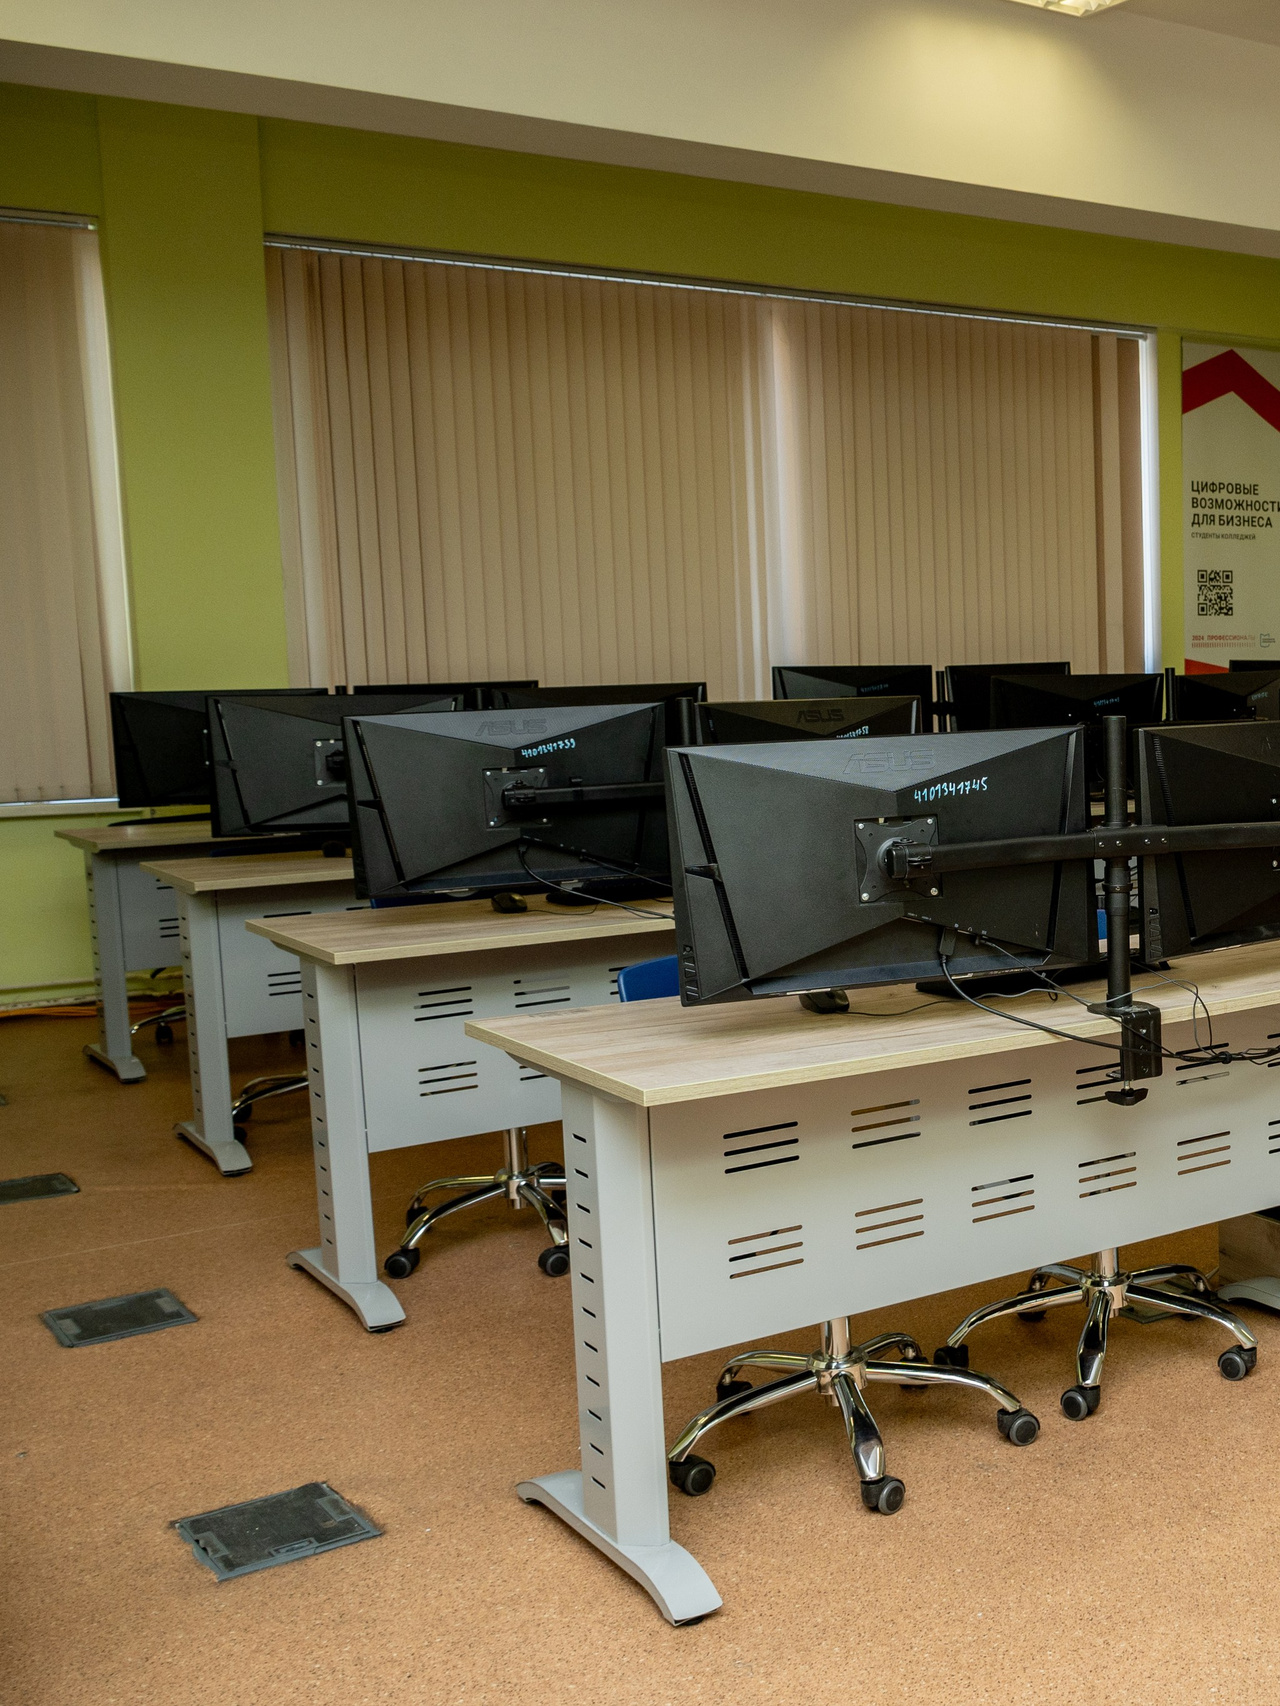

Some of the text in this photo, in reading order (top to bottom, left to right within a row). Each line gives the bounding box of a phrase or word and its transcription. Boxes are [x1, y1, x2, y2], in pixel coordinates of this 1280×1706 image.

[1191, 480, 1259, 496] ЦИФРОВЫЕ
[1191, 513, 1273, 528] ДЛЯ БИЗНЕСА
[1191, 532, 1256, 541] СТУДЕНТЫ КОЛЛЕДЖЕЙ
[797, 708, 845, 723] ASUS
[475, 718, 549, 737] ASUS
[521, 738, 577, 758] 4101341759
[842, 749, 937, 775] ASUS
[913, 776, 989, 804] 4101341745
